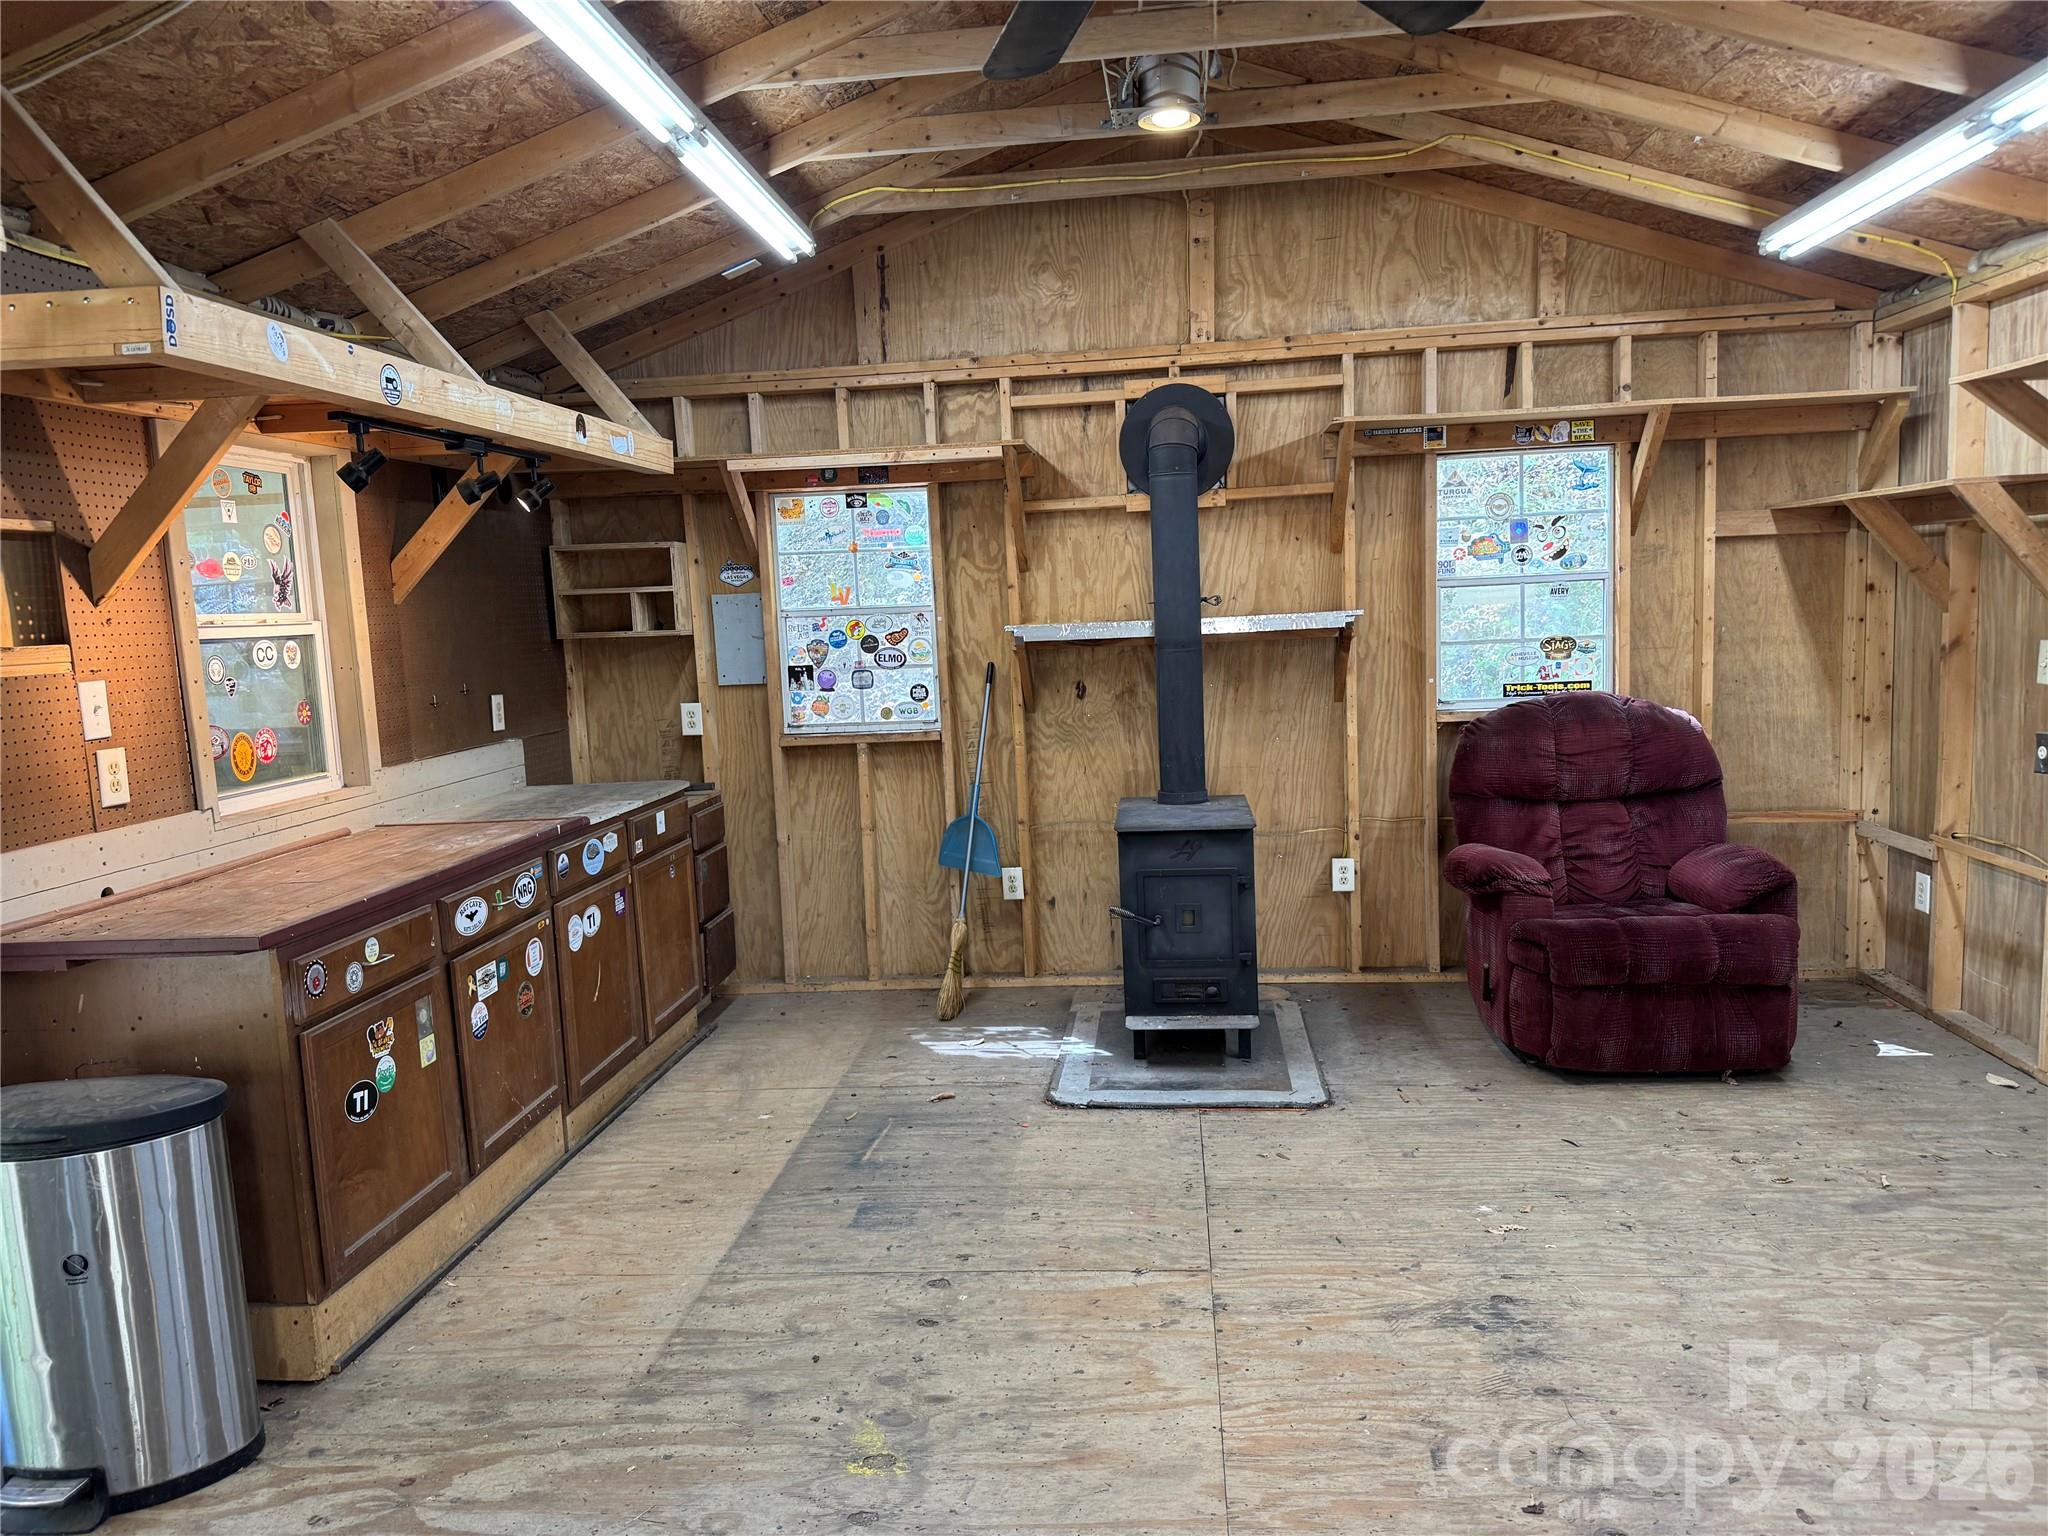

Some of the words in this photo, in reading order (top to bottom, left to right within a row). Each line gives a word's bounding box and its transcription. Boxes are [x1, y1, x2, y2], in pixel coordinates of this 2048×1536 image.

[1551, 587, 1569, 595] AVERY
[1543, 639, 1576, 651] STAGE
[256, 646, 274, 663] CC
[878, 653, 903, 663] ELMO
[1504, 682, 1591, 692] Trick-Tools.com
[898, 707, 919, 715] WGB
[517, 880, 533, 900] NRG
[586, 912, 596, 929] TI
[353, 1089, 369, 1113] TI
